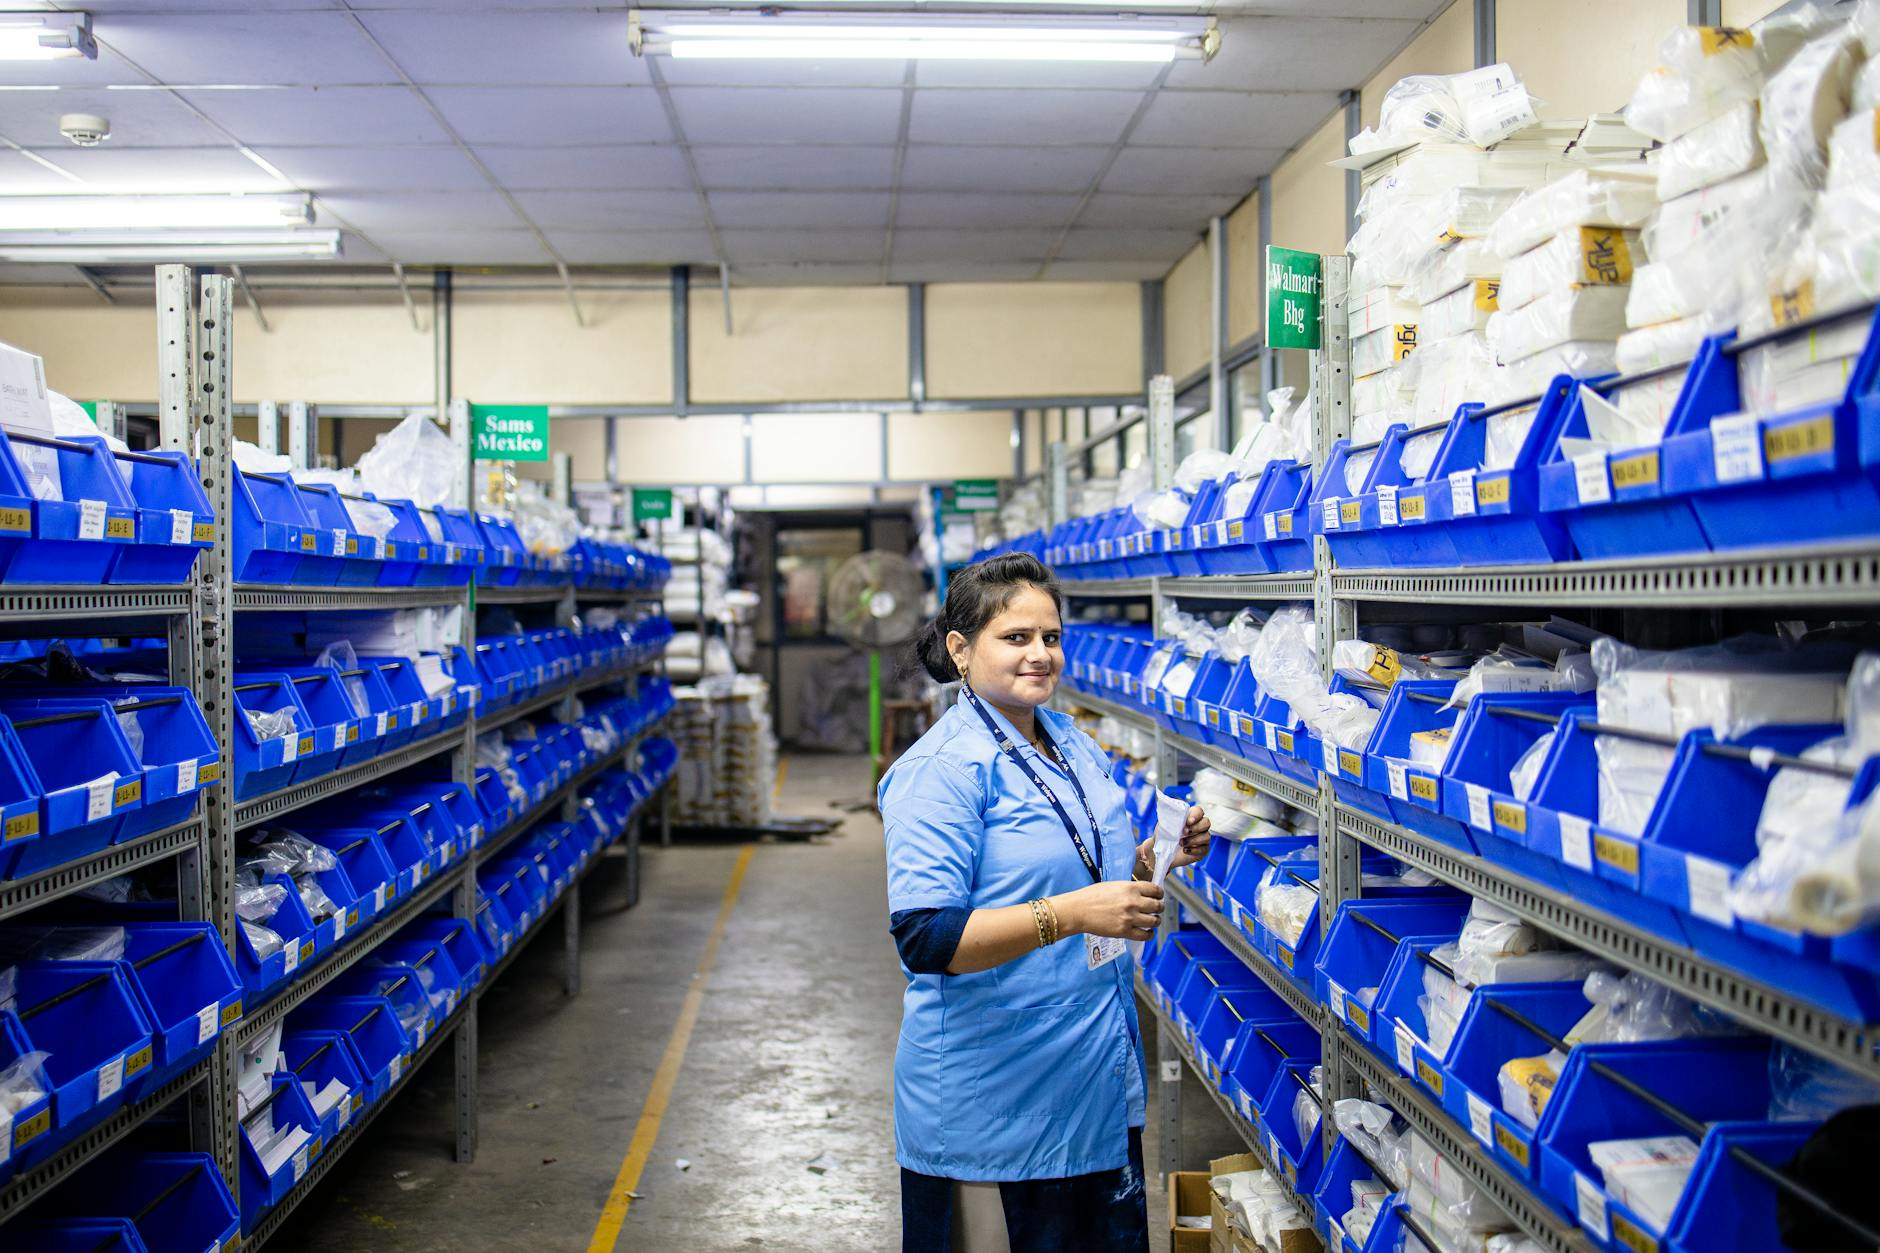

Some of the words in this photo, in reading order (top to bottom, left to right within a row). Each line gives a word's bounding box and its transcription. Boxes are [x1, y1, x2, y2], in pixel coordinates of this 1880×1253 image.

[1272, 263, 1317, 294] Walmart
[1283, 298, 1304, 334] Bhg
[485, 414, 534, 433] Sams
[478, 433, 543, 452] Mexico
